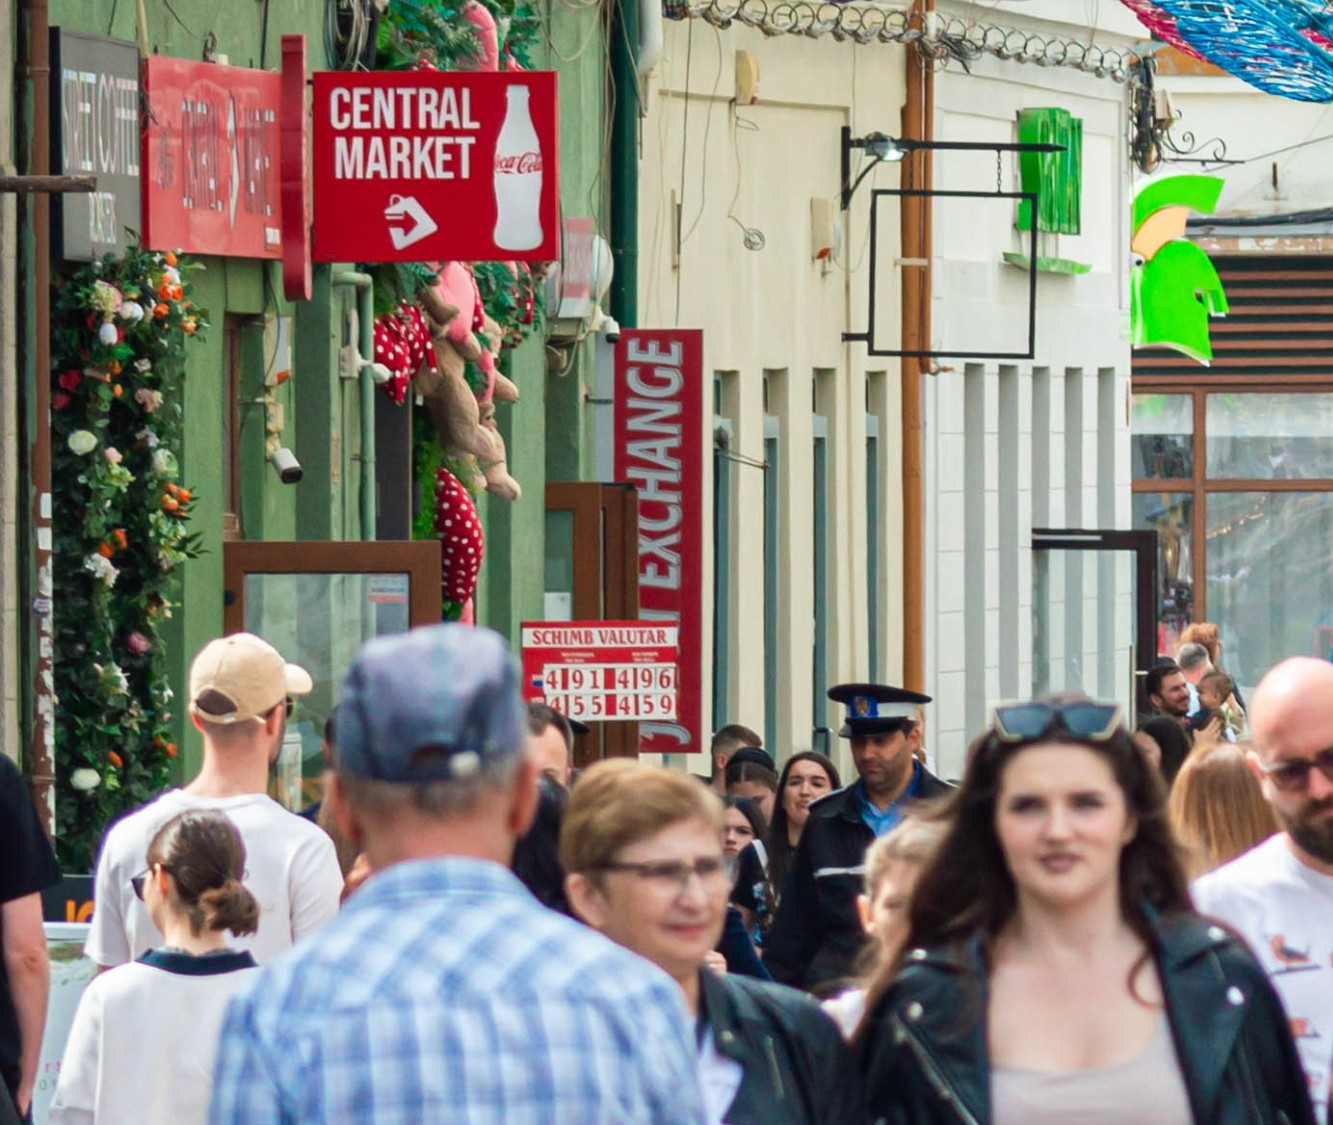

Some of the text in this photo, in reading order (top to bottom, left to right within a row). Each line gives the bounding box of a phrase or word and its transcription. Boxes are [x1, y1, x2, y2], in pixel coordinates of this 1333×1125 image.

[330, 86, 481, 130] CENTRAL
[334, 136, 476, 179] MARKET
[626, 338, 683, 591] EXCHANGE
[532, 629, 667, 646] SCHIMB VALUTAR
